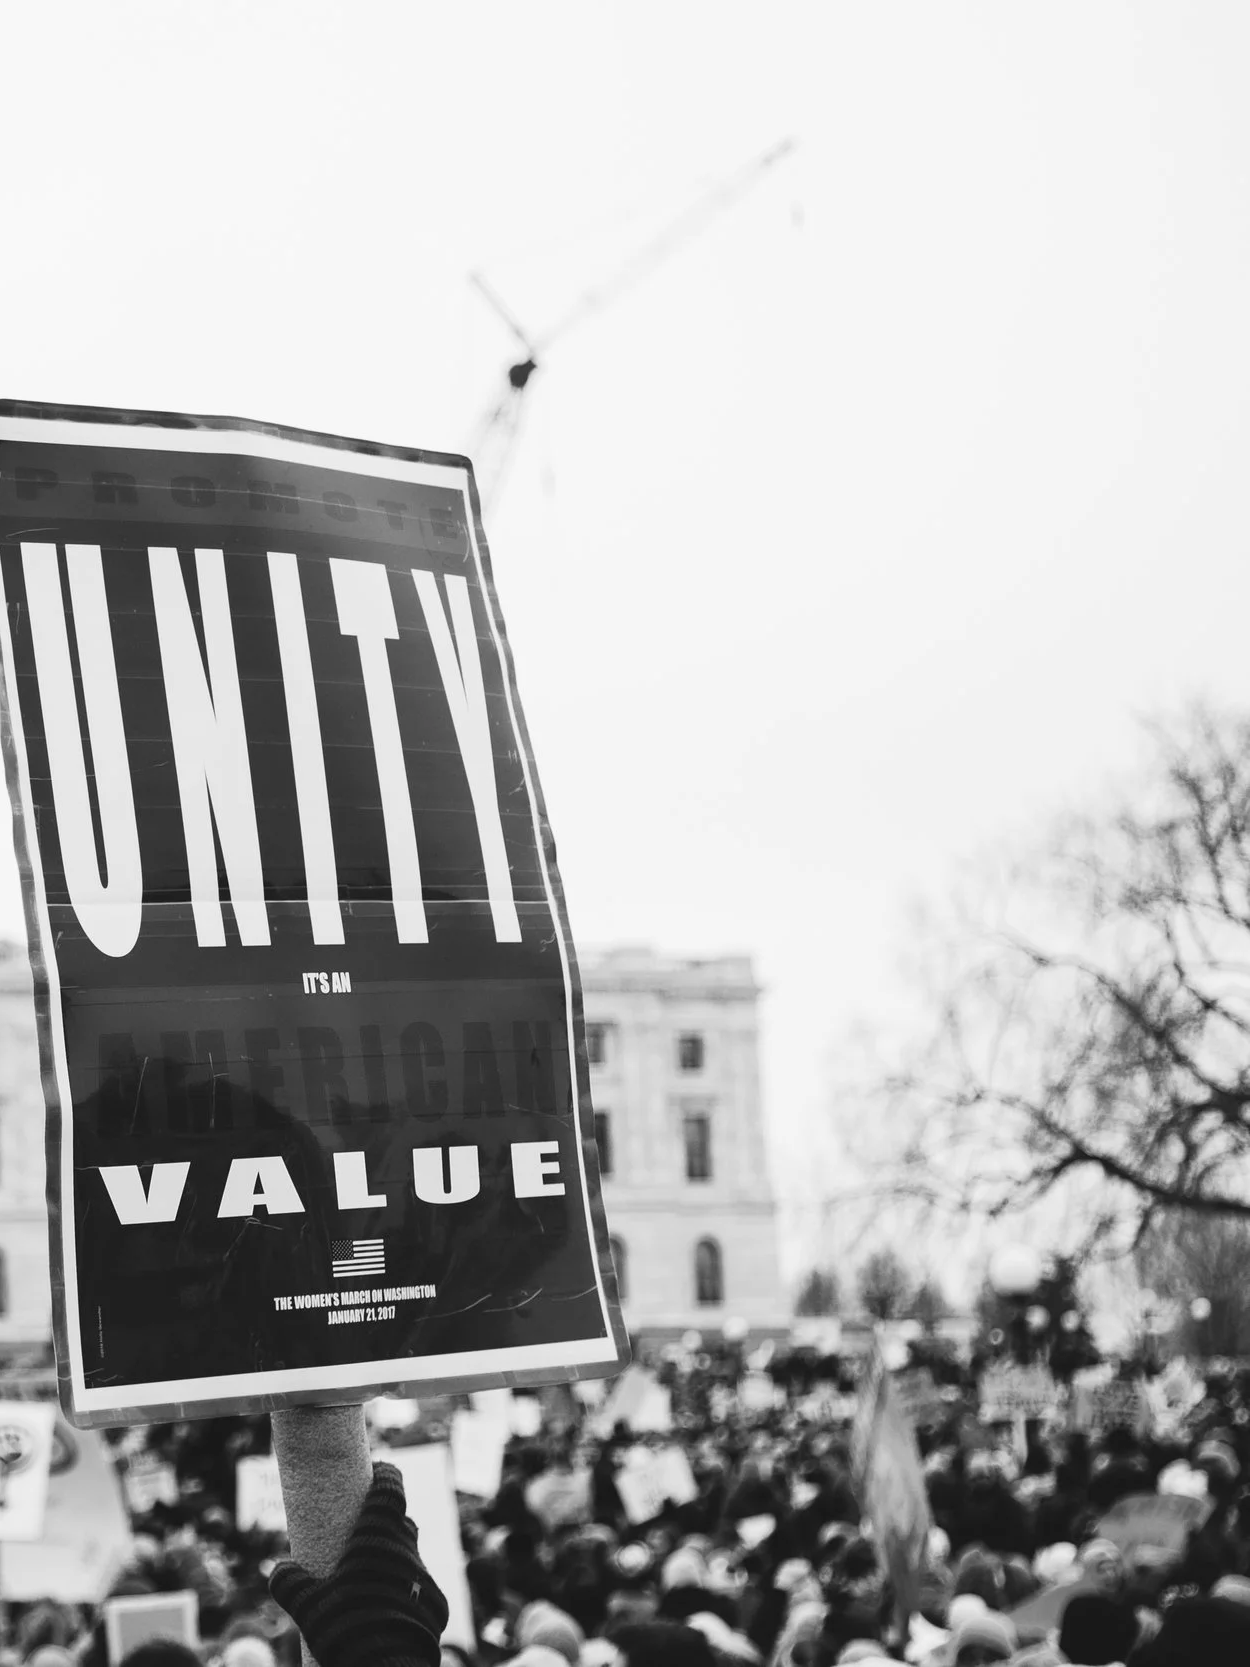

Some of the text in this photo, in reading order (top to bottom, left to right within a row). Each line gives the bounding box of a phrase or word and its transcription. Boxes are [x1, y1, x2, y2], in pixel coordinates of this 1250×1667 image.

[15, 466, 458, 539] PROMOTE
[20, 542, 522, 957] UNITY
[302, 972, 351, 994] IT'S AN
[97, 1021, 558, 1137] AMERICAN
[99, 1141, 565, 1225] VALUE
[274, 1284, 436, 1311] THE WOMEN'S MARCH ON WASHINGTON
[328, 1306, 396, 1325] JANUARY 21, 2017
